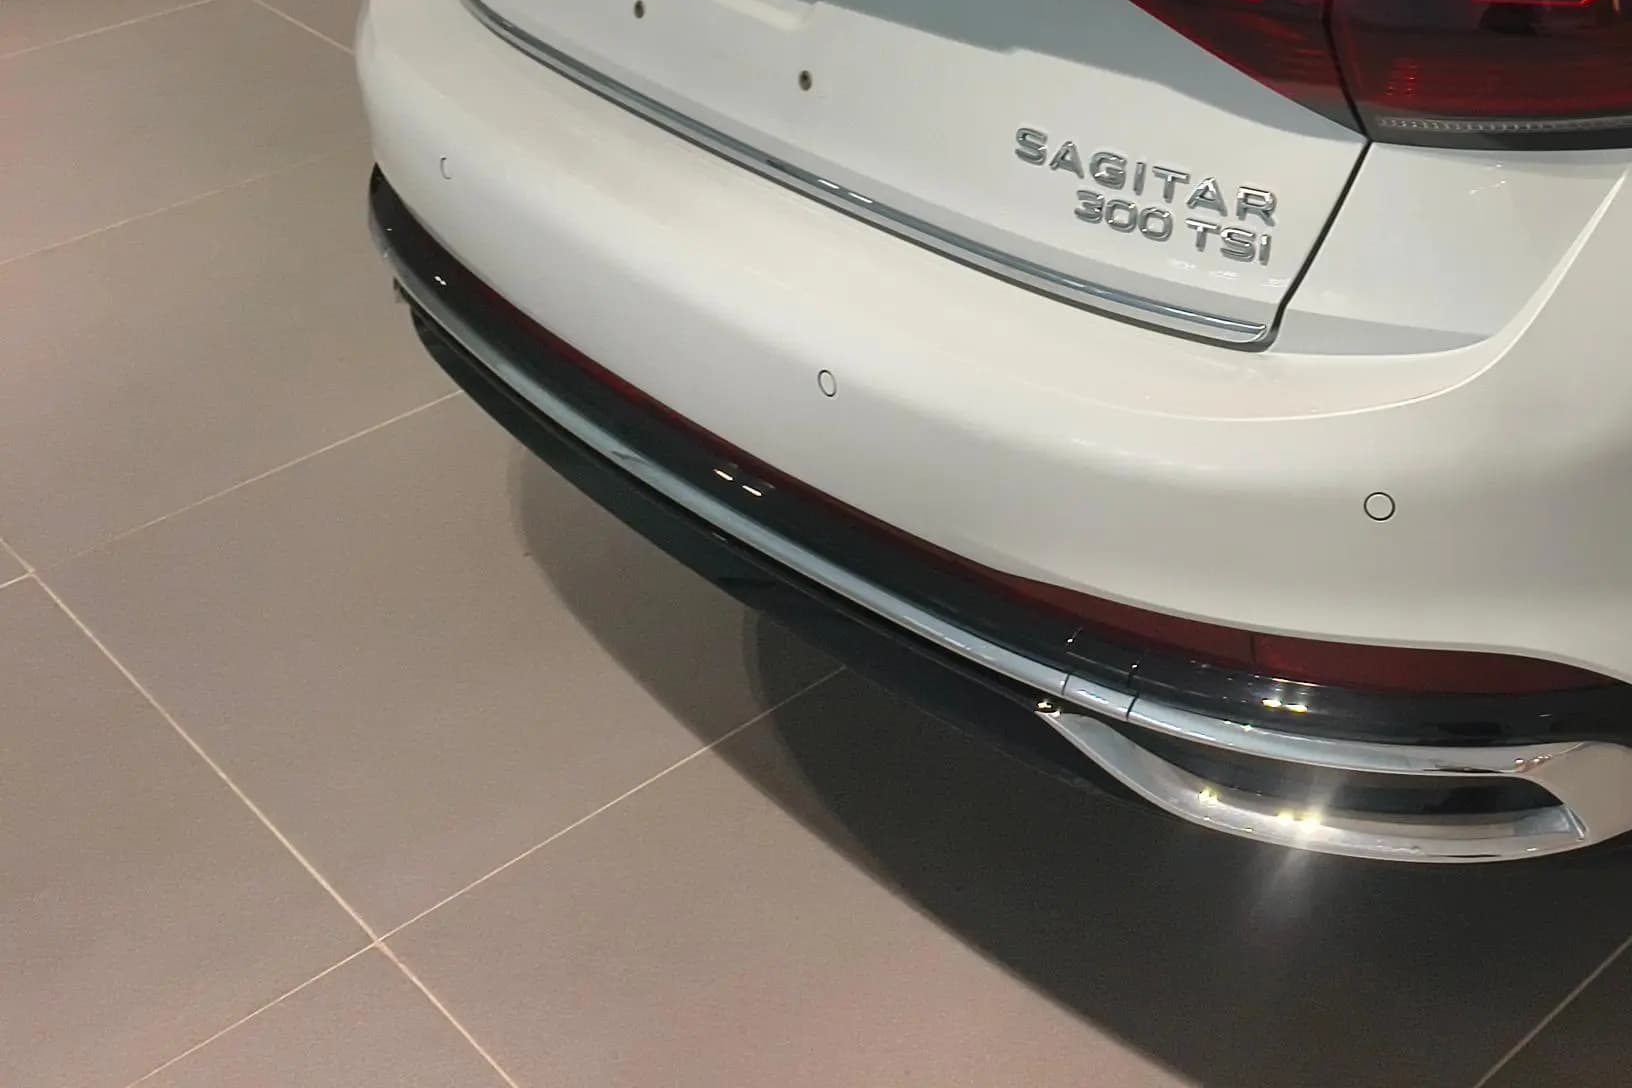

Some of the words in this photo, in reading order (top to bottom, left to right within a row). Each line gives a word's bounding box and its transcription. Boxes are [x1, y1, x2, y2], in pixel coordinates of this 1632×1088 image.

[1014, 127, 1278, 226] SAGITAR
[1074, 188, 1174, 242] 300
[1185, 217, 1272, 266] TSI
